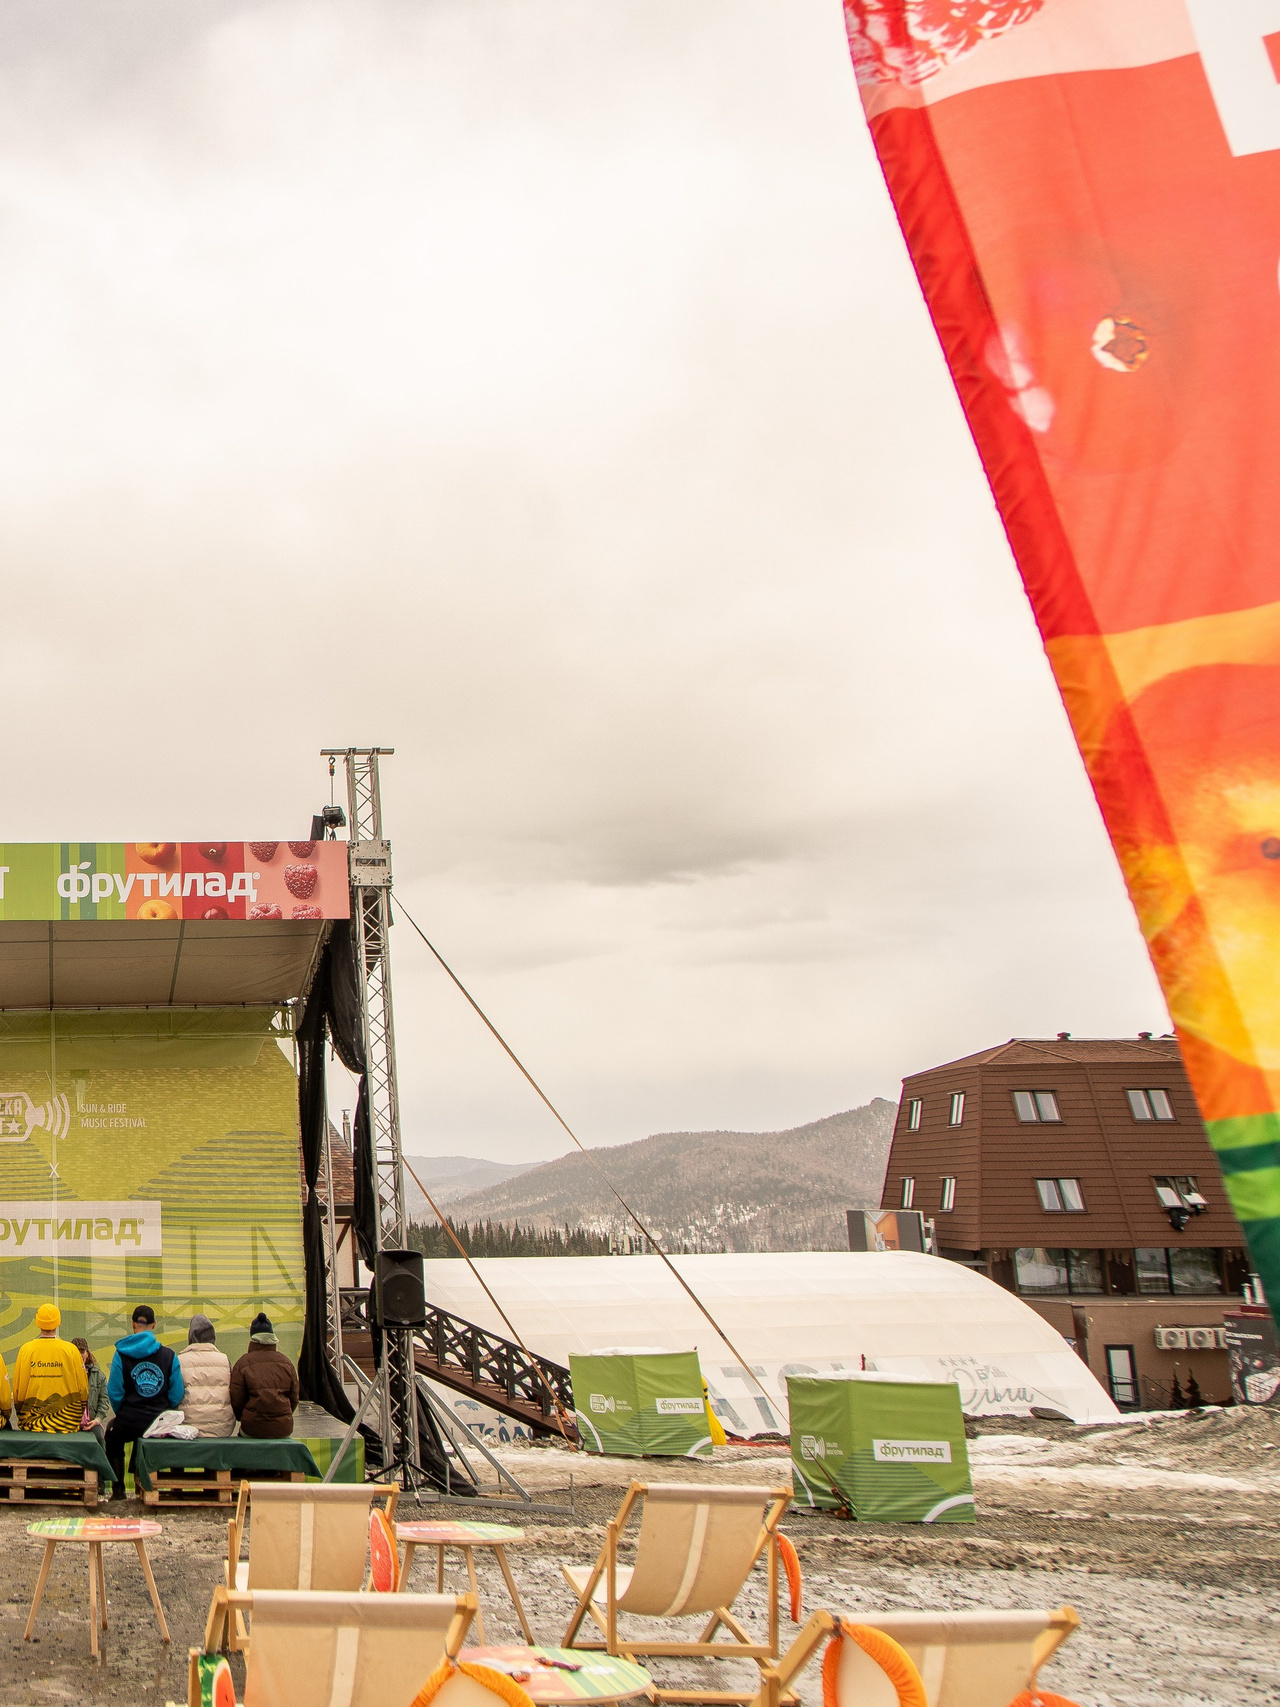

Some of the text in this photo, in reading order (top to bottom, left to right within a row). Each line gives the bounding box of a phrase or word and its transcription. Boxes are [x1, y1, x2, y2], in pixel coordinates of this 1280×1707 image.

[57, 861, 259, 903] фрутилад
[81, 1104, 98, 1114] SUN
[107, 1104, 127, 1114] RIDE
[81, 1118, 147, 1128] MUSIC FESTIVAL
[660, 1400, 700, 1411] фрутилад
[880, 1442, 945, 1458] фрутилад
